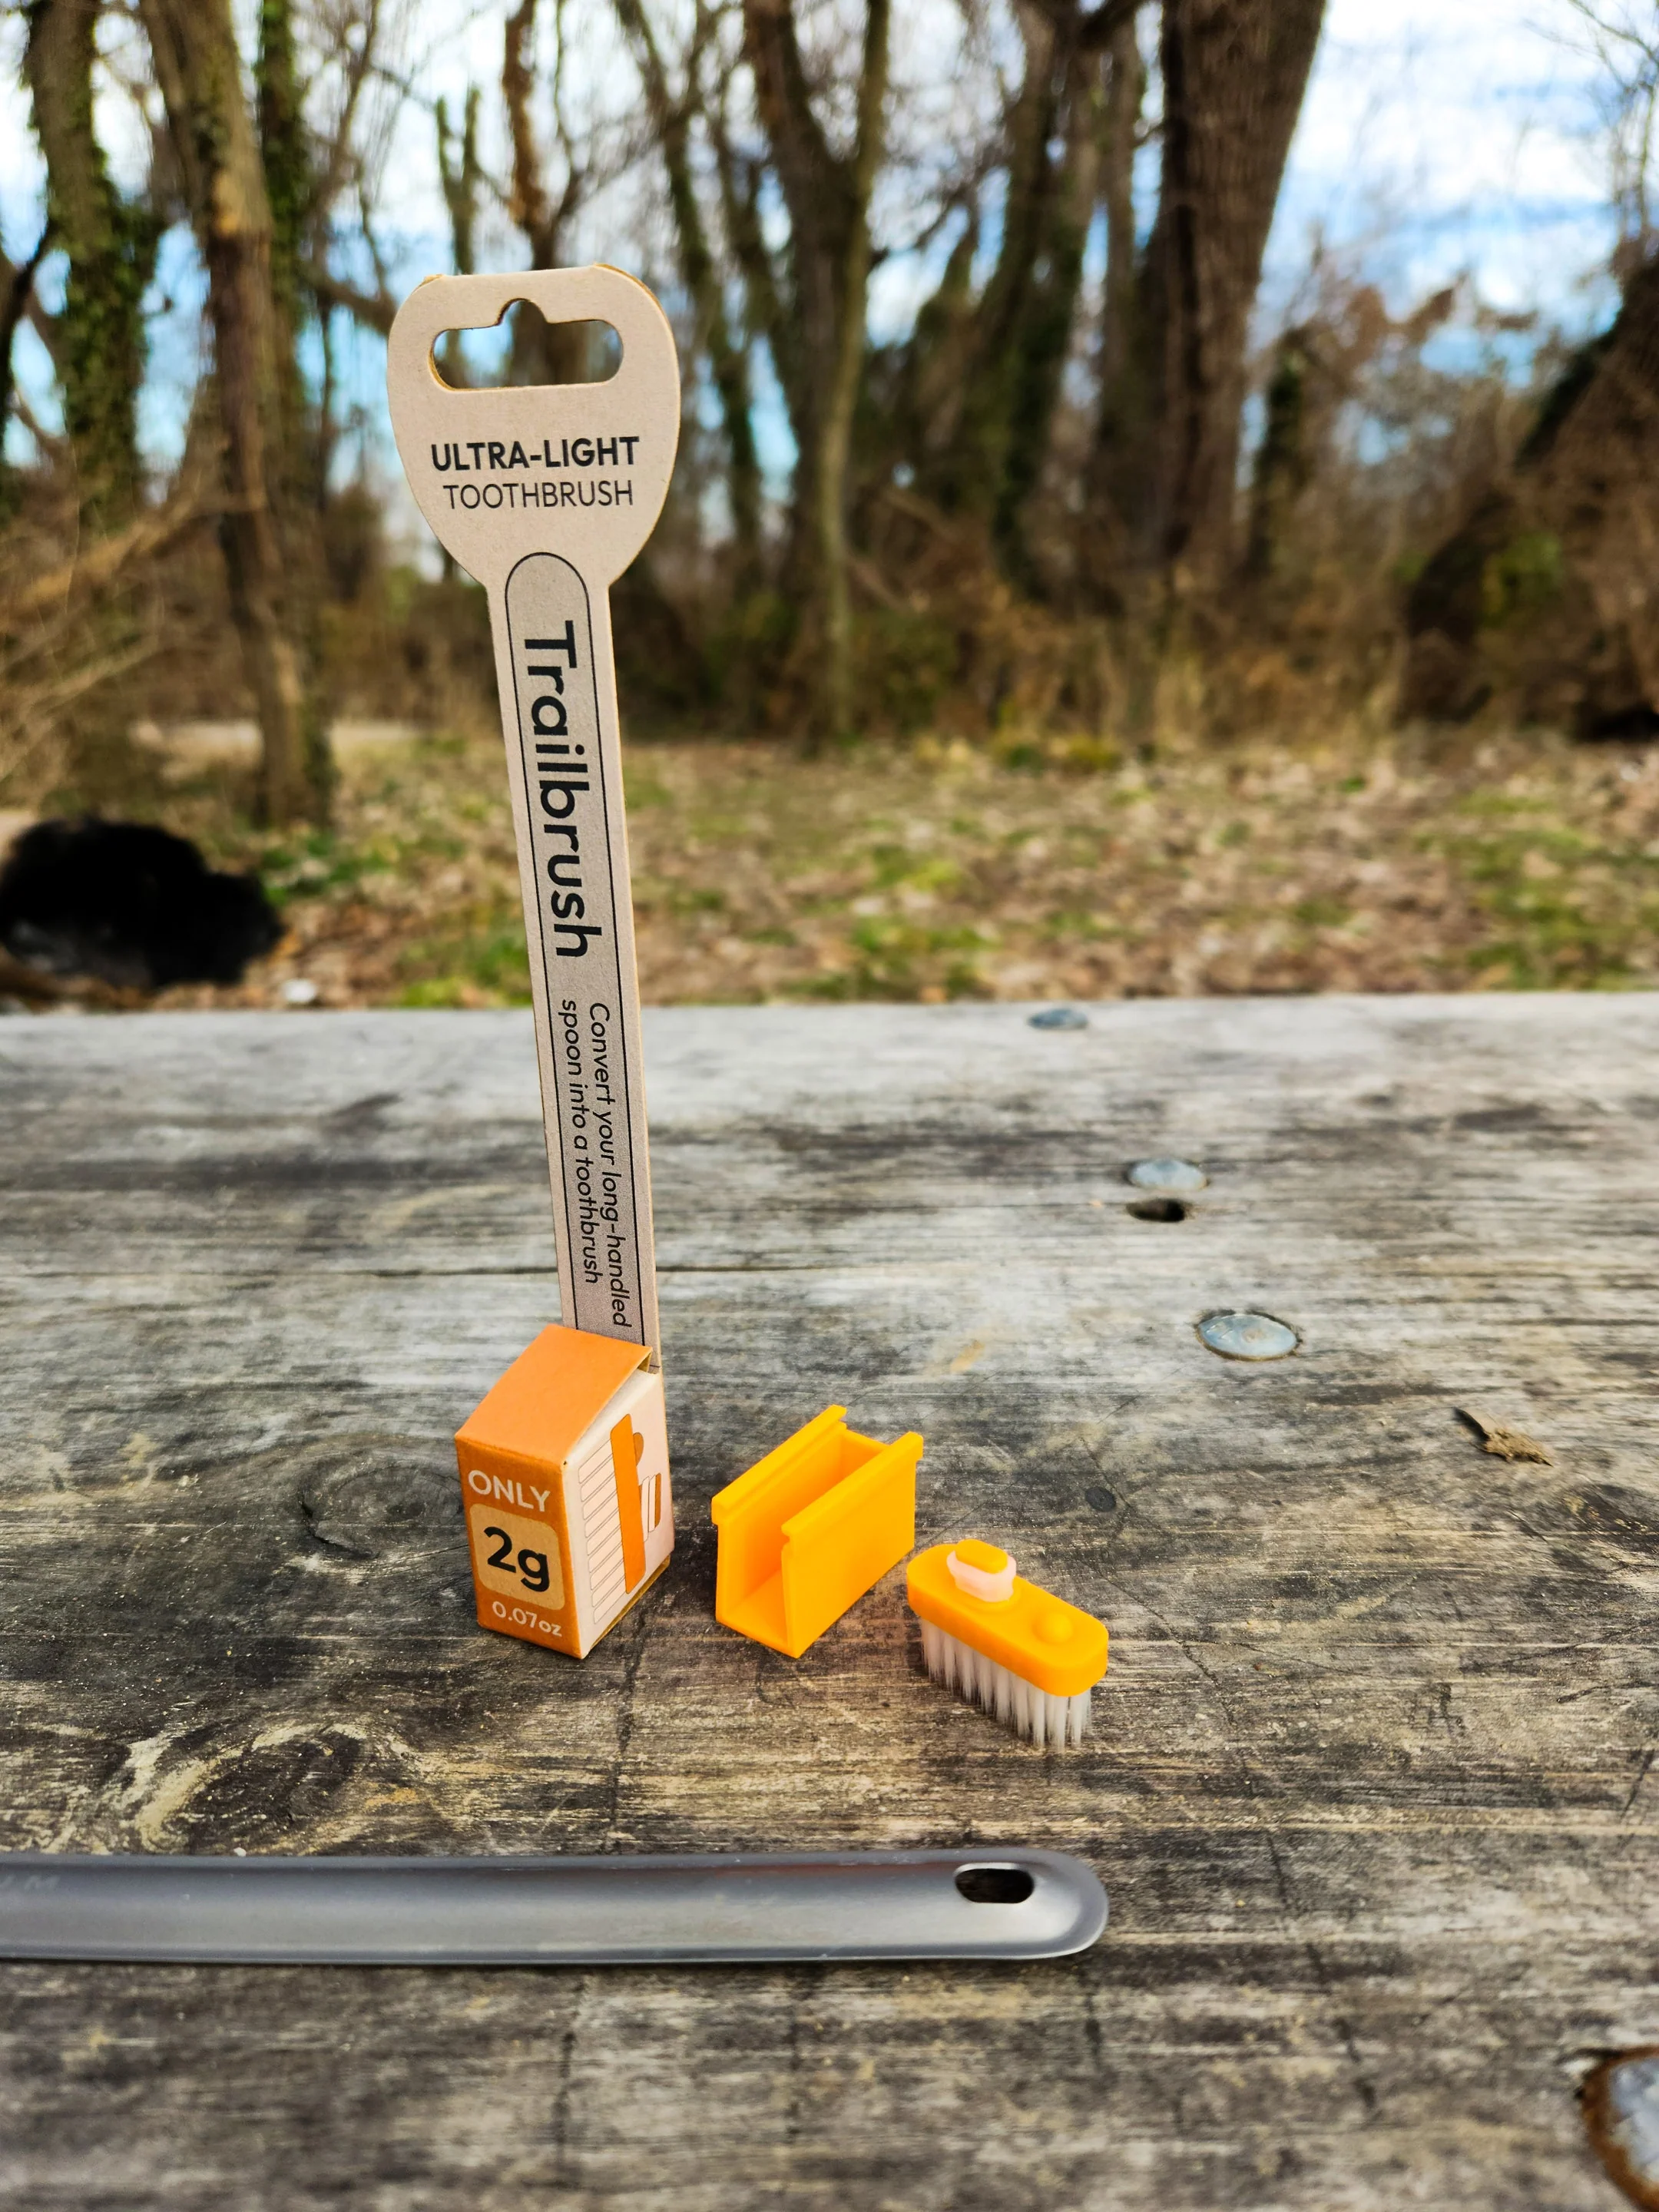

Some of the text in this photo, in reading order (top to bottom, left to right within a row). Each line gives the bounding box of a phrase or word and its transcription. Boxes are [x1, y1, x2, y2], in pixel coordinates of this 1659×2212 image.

[431, 436, 639, 471] ULTRA-LIGHT
[443, 479, 633, 509] TOOTHBRUSH
[525, 621, 601, 957] Trailbrush
[558, 1000, 603, 1284] spoon into a toothbrush
[589, 1002, 632, 1327] Convert your long-handled
[469, 1470, 551, 1512] ONLY
[483, 1526, 550, 1592] 2g
[492, 1601, 562, 1637] 0.07oz
